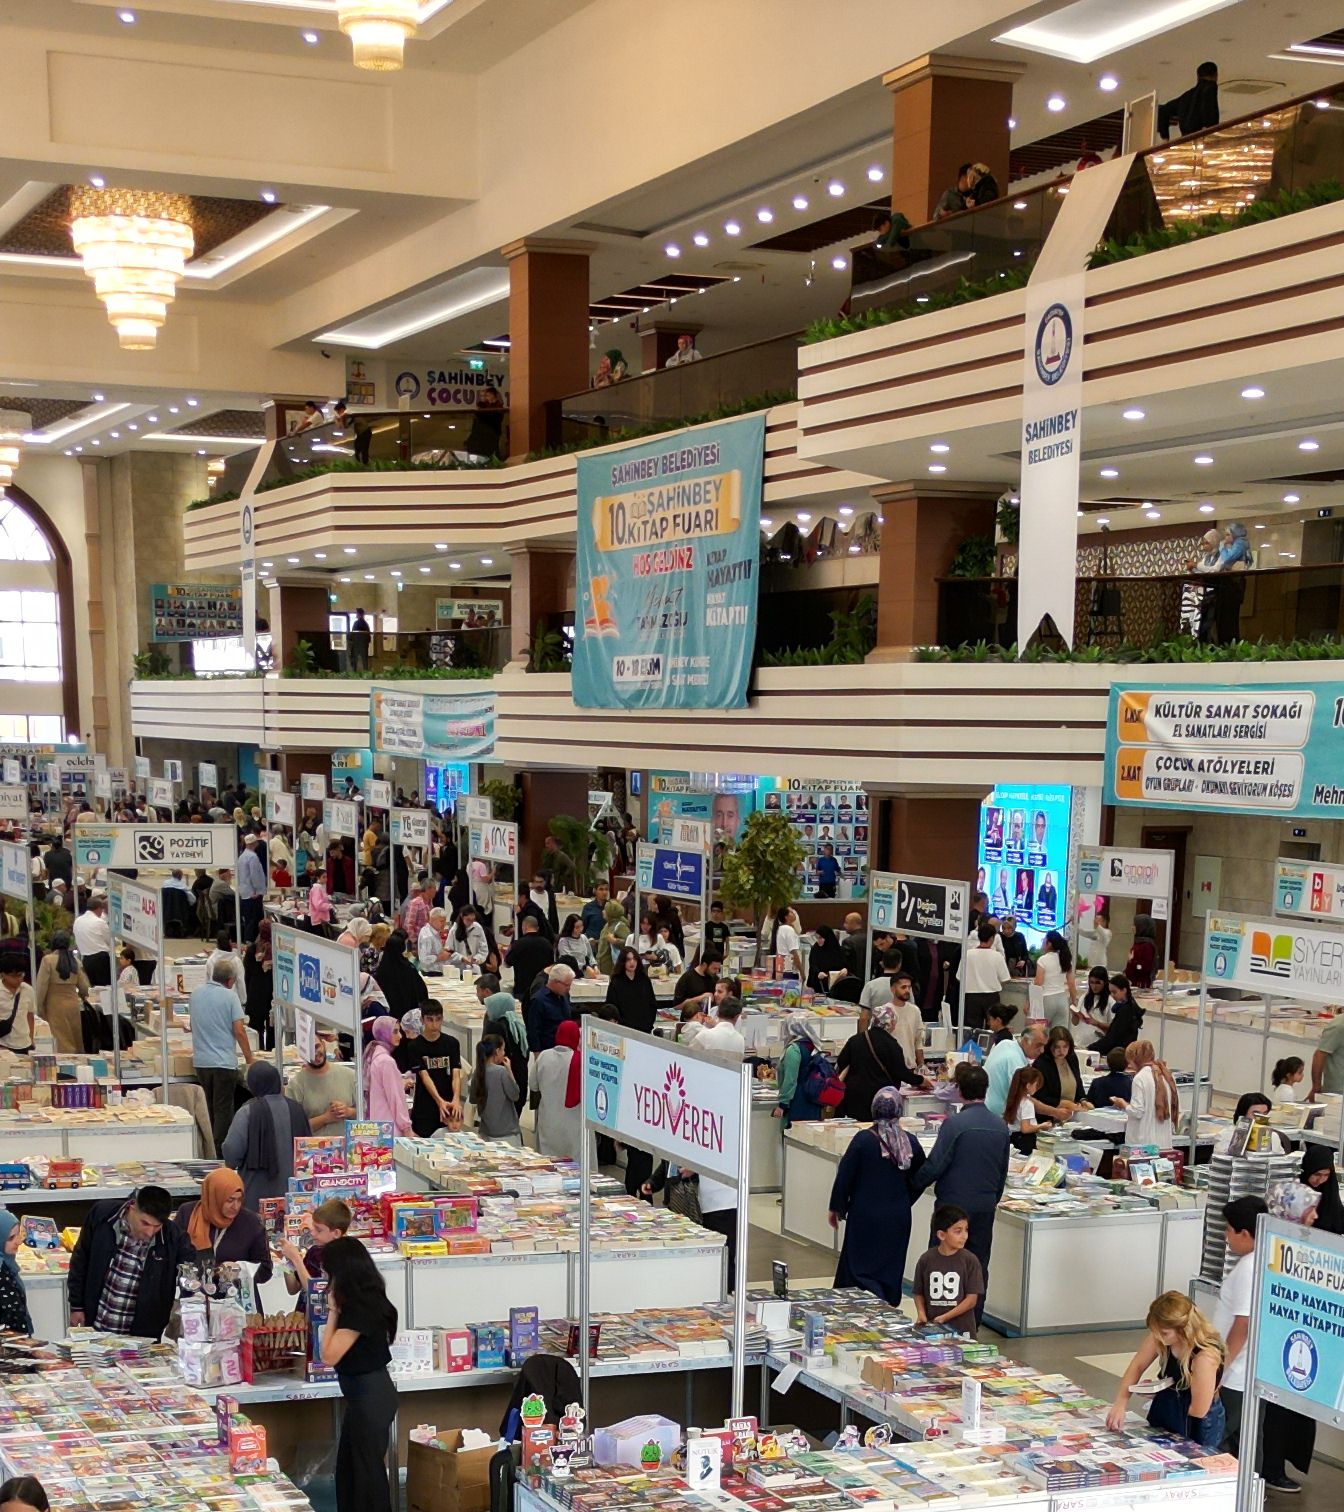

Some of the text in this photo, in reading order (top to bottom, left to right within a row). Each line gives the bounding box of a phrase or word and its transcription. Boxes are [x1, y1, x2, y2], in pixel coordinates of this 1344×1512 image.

[427, 387, 477, 406] ÇOCU
[1025, 409, 1078, 444] ŞAHİNBEY
[612, 442, 720, 487] ŞAHİNBEY BELEDİYESİ
[647, 478, 723, 516] ŞAHİNBEY
[673, 508, 719, 536] FUARI
[1154, 700, 1303, 720] KÜLTÜR SANAT SOKAĞI
[1155, 756, 1274, 776] ÇOCUK ATÖLYELERİ
[170, 836, 209, 848] POZİTİF
[1293, 963, 1342, 986] YAYINLARI
[1294, 1262, 1323, 1284] KİTAP
[930, 1271, 960, 1299] 89
[1270, 1282, 1299, 1303] KİTAP
[1269, 1302, 1299, 1324] HAYAT
